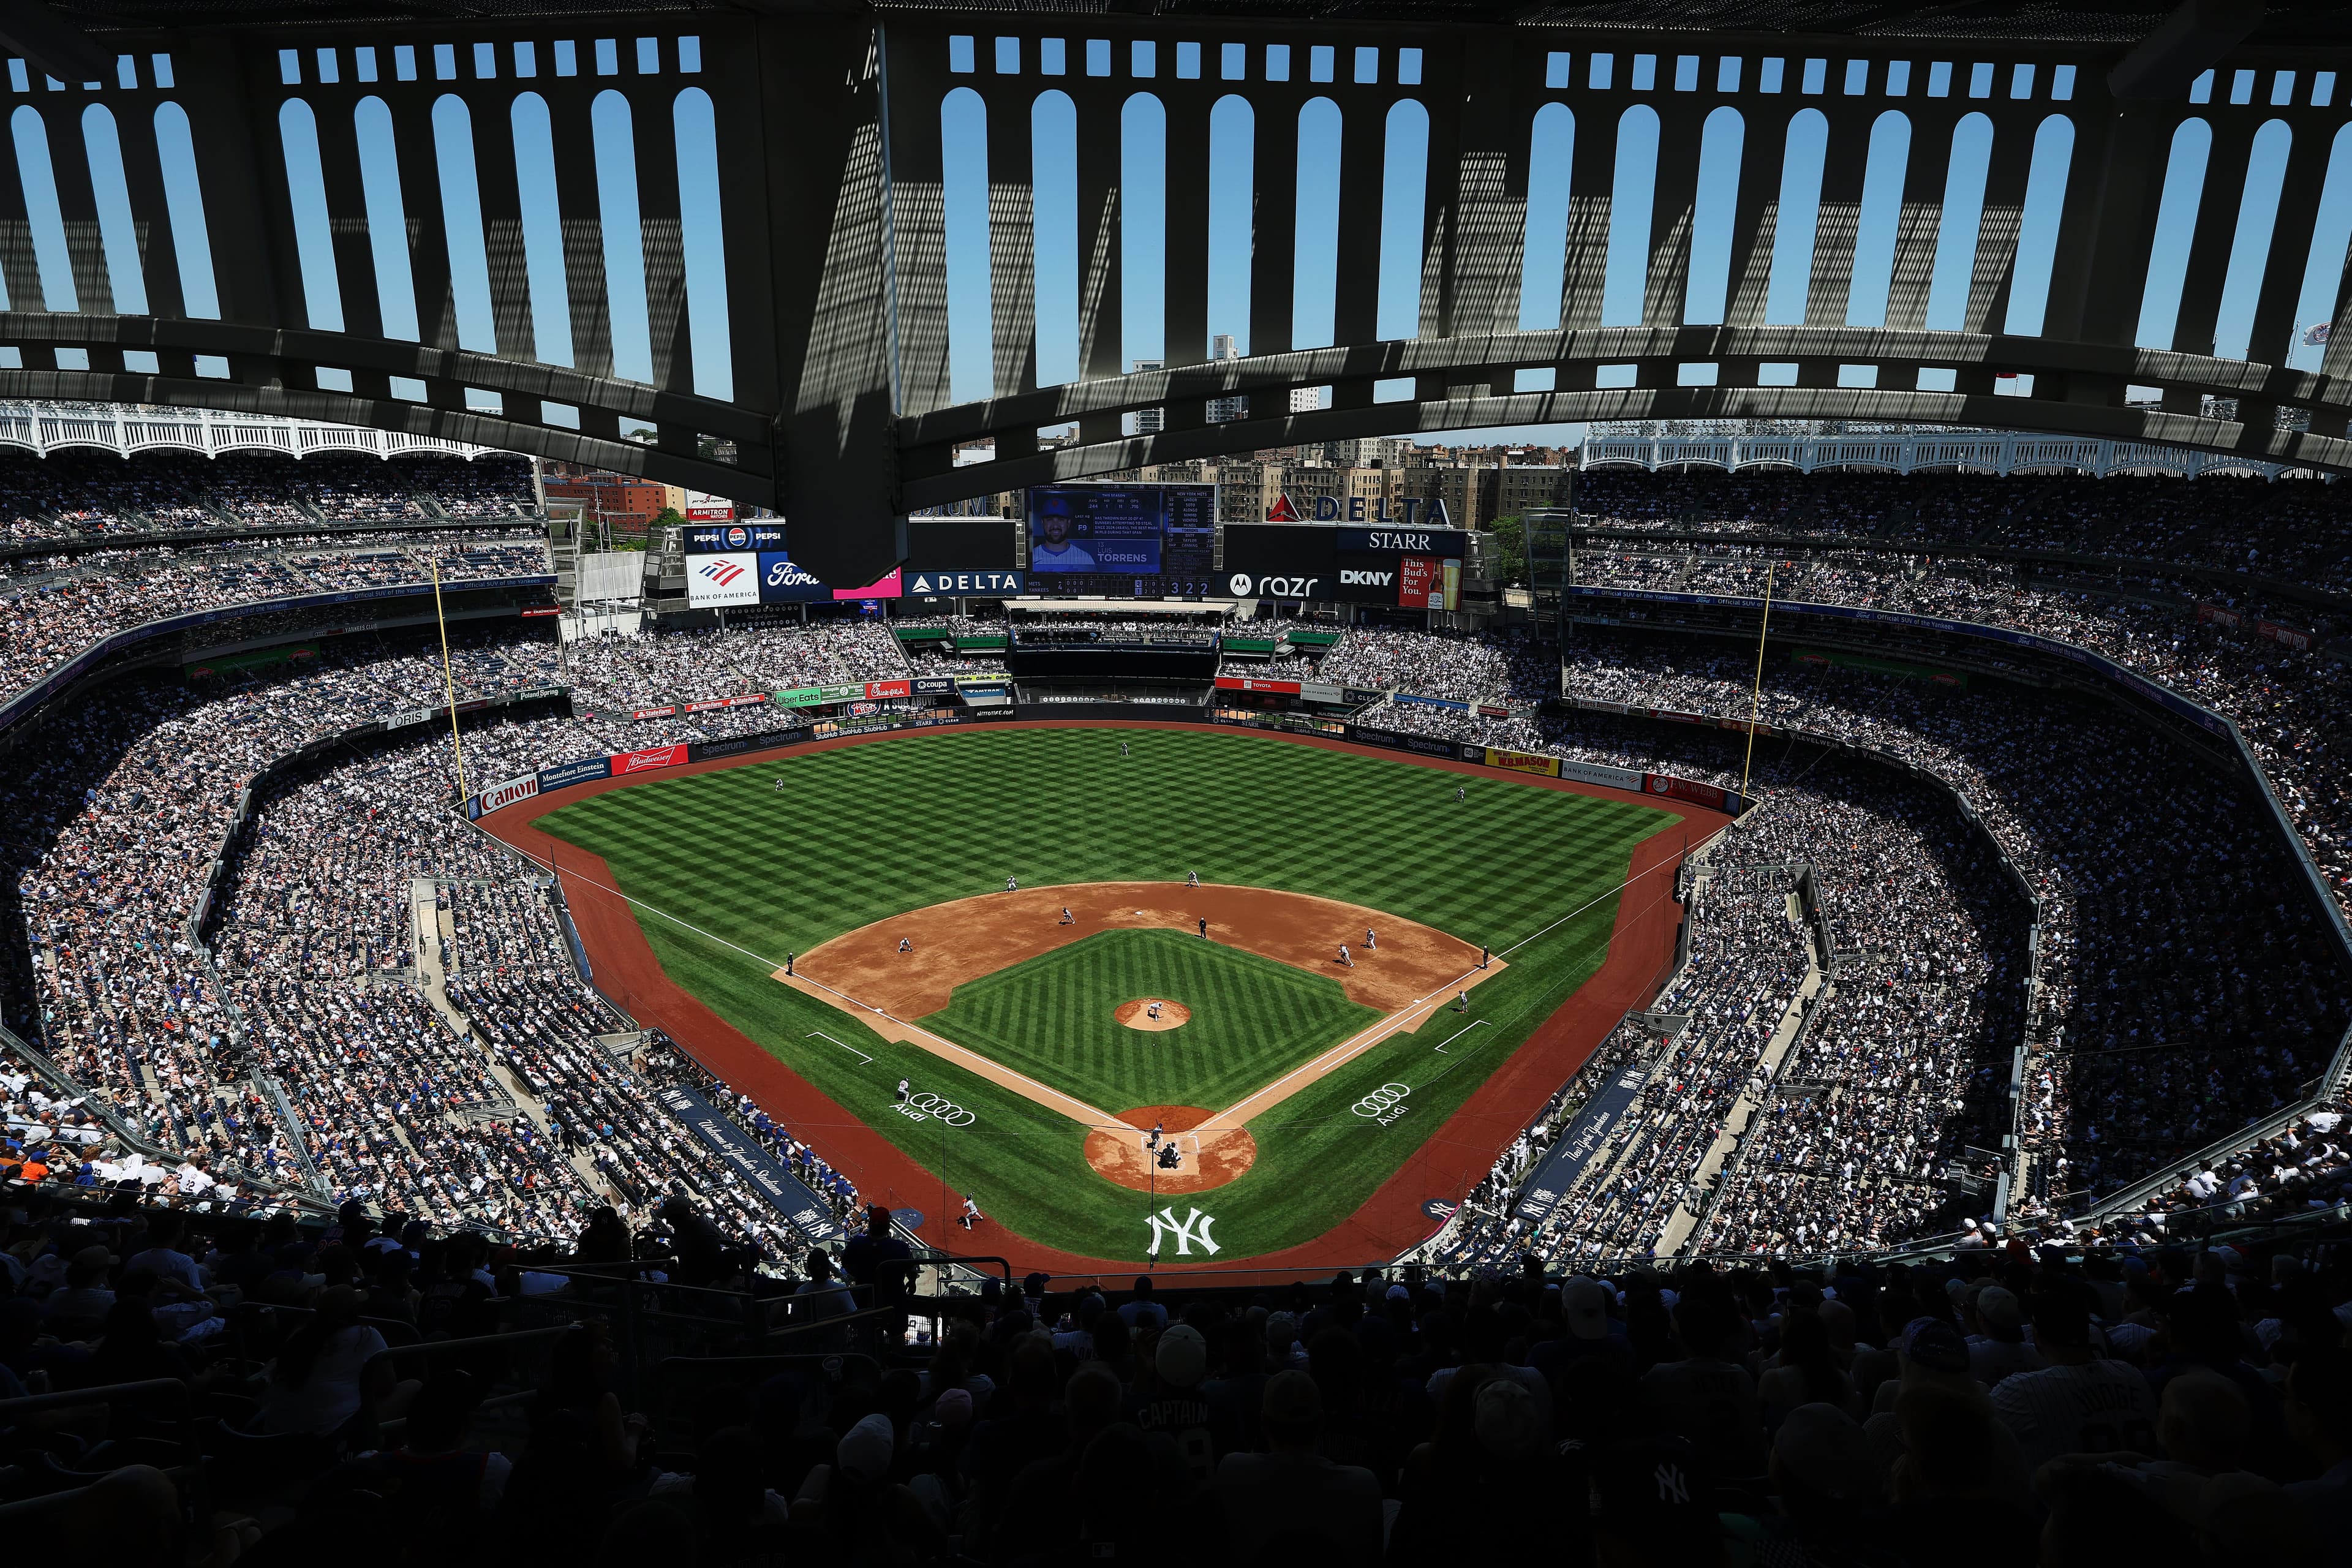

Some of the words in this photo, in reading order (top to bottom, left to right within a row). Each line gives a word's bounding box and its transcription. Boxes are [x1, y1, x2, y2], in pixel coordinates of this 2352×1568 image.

[1316, 496, 1450, 525] DELTA
[1369, 532, 1431, 550] STARR
[1404, 558, 1424, 567] This
[1340, 570, 1393, 586] DKNY
[1404, 568, 1428, 577] Bud's
[939, 574, 1017, 590] DELTA
[1171, 582, 1179, 594] 3
[1186, 582, 1193, 594] 2
[1200, 583, 1208, 594] 2
[1260, 577, 1318, 597] razr
[1403, 577, 1418, 585] For
[355, 591, 373, 599] Official
[1403, 586, 1421, 595] You.
[1877, 614, 1899, 623] Official
[2213, 611, 2225, 625] PARTY
[2277, 629, 2292, 645] PARTY
[2293, 634, 2308, 651] DECK
[521, 691, 539, 701] Poland
[540, 689, 558, 698] Spring
[871, 683, 905, 697] Chick-fil-A
[778, 695, 797, 705] Uber
[799, 693, 819, 702] Eats
[884, 700, 890, 710] A
[911, 695, 937, 707] ABOVE
[1596, 701, 1624, 711] Authority
[395, 712, 422, 726] ORIS
[347, 726, 377, 739] LEVELWEAR
[816, 731, 838, 740] StubHub
[839, 728, 862, 736] StubHub
[864, 725, 887, 733] StubHub
[702, 741, 745, 755] Spectrum
[760, 732, 799, 745] Spectrum
[1356, 730, 1393, 744] Spectrum
[1408, 738, 1447, 753] Spectrum
[631, 754, 670, 766] Budweiser
[1797, 735, 1839, 749] LEVELWEAR
[1870, 754, 1904, 770] LEVELWEAR
[1499, 757, 1550, 768] W.B.MASON
[543, 770, 576, 782] Montefiore
[577, 762, 604, 773] Einstein
[1593, 772, 1623, 782] AMERICA
[482, 779, 536, 811] Canon
[1671, 780, 1687, 792] F.W.
[1691, 784, 1717, 798] WEBB
[889, 1104, 928, 1122] Audi
[1377, 1104, 1409, 1127] Audi
[1562, 1147, 1582, 1161] New
[1573, 1134, 1594, 1151] York
[1587, 1112, 1610, 1137] Yankees
[698, 1119, 727, 1147] Welcome
[721, 1146, 758, 1171] Yankee
[752, 1170, 783, 1196] Stadium
[1521, 1204, 1546, 1218] NY
[808, 1223, 834, 1237] NY
[1144, 1206, 1221, 1256] NY
[2077, 1384, 2141, 1413] JUDGE
[1137, 1399, 1209, 1430] CAPTAIN
[1654, 1461, 1691, 1504] NY
